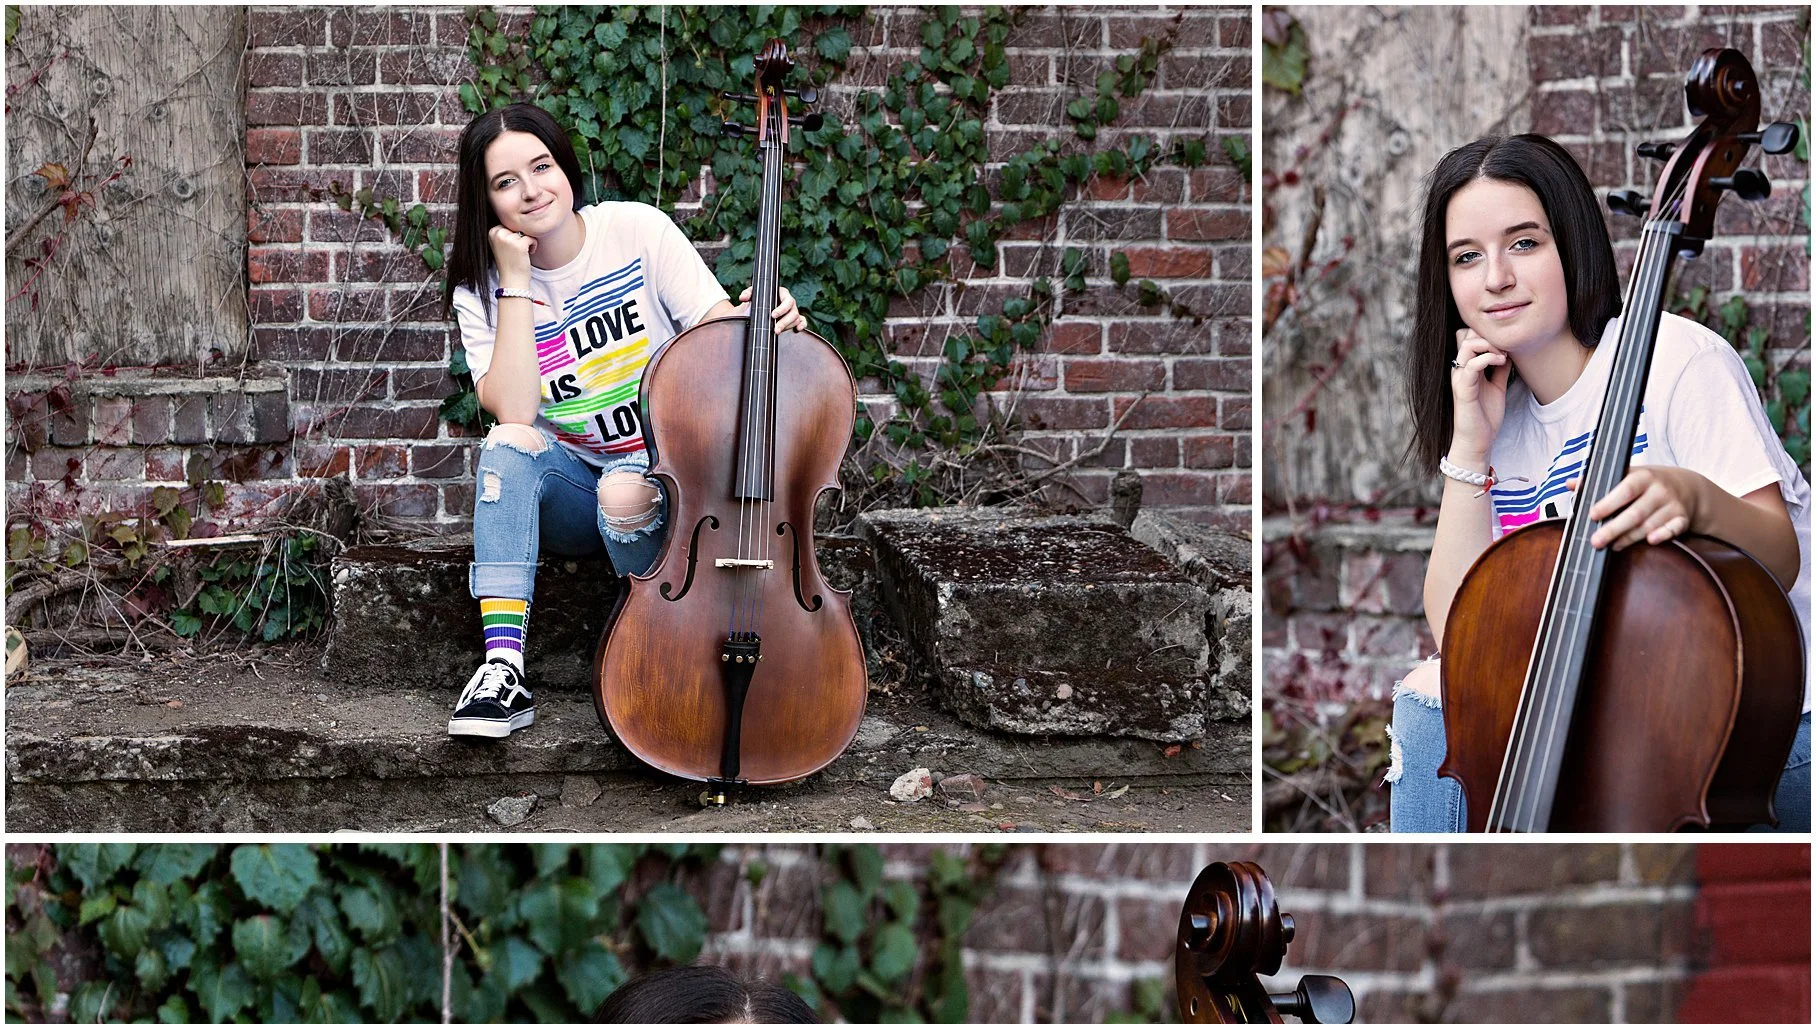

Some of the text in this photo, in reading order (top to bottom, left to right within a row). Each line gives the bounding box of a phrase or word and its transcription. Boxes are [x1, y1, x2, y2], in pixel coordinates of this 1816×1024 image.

[570, 299, 645, 360] LOVE
[549, 374, 582, 403] IS
[595, 400, 638, 442] LO
